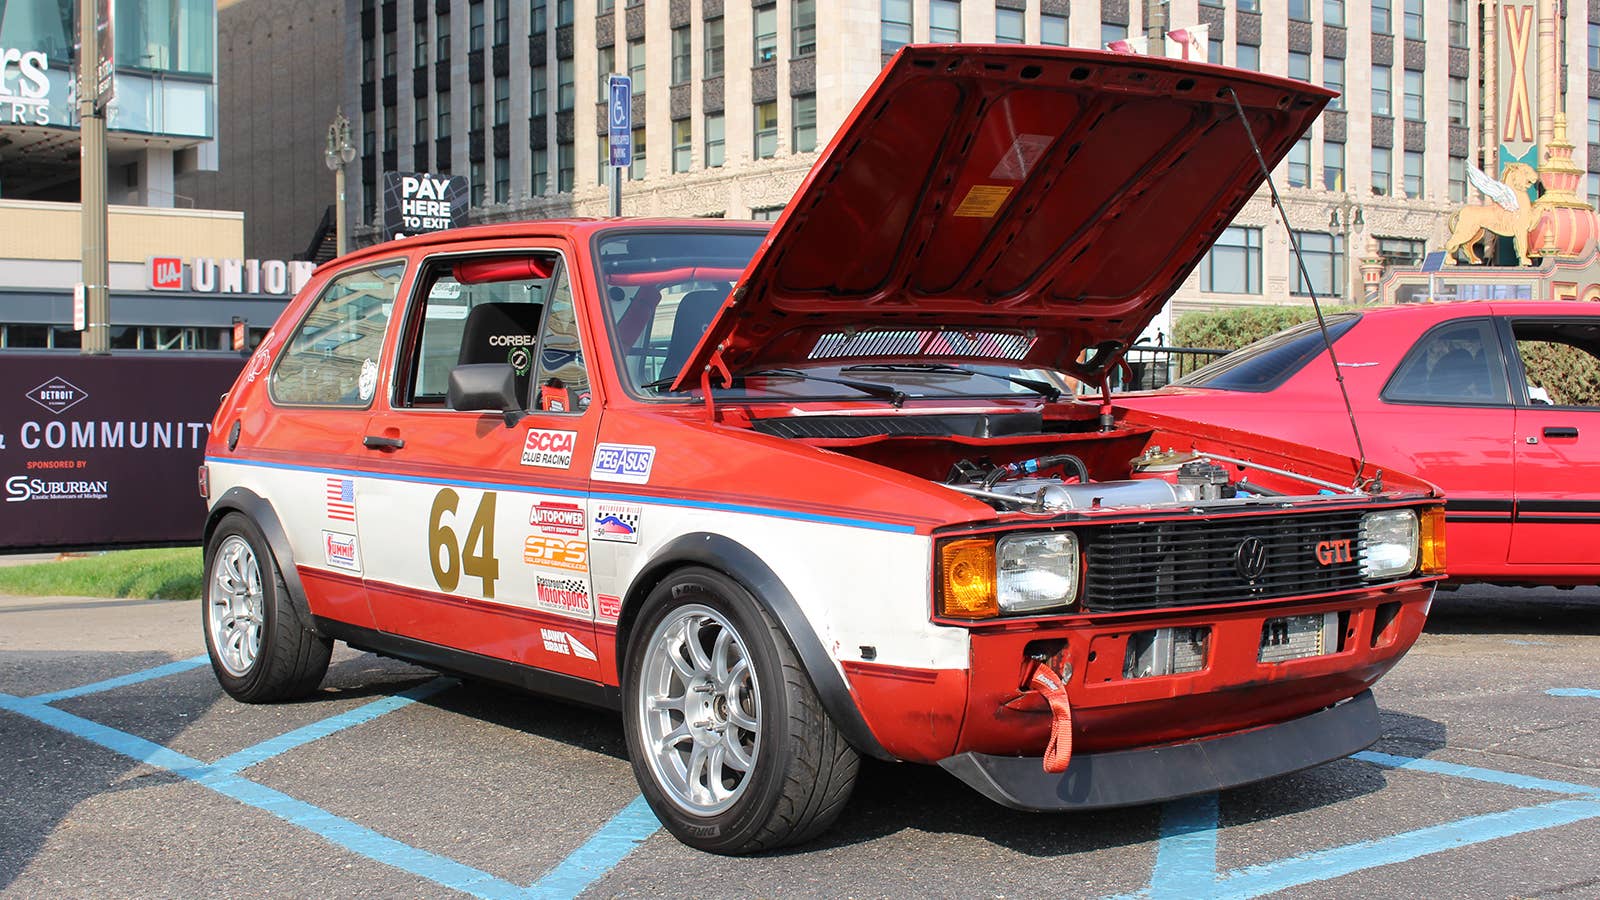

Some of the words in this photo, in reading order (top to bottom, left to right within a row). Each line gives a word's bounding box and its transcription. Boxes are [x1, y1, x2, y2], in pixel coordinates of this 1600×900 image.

[1503, 5, 1534, 142] X
[402, 176, 451, 200] PAY
[402, 200, 451, 217] HERE
[402, 216, 421, 228] TO
[422, 217, 451, 229] EXIT
[40, 390, 73, 400] DETROIT
[526, 432, 573, 452] SCCA
[26, 461, 75, 470] SPONSORED
[76, 460, 87, 469] BY
[522, 451, 541, 463] CLUB
[542, 452, 571, 466] RACING
[596, 448, 651, 474] PEGASUS
[30, 479, 108, 495] SUBURBAN
[529, 506, 584, 526] AUTOPOWER
[428, 487, 499, 599] 64
[524, 537, 588, 563] SPS
[1315, 539, 1353, 566] GTI
[537, 584, 589, 611] Motorsports
[540, 628, 567, 644] HAWK
[543, 640, 571, 655] BRAKE
